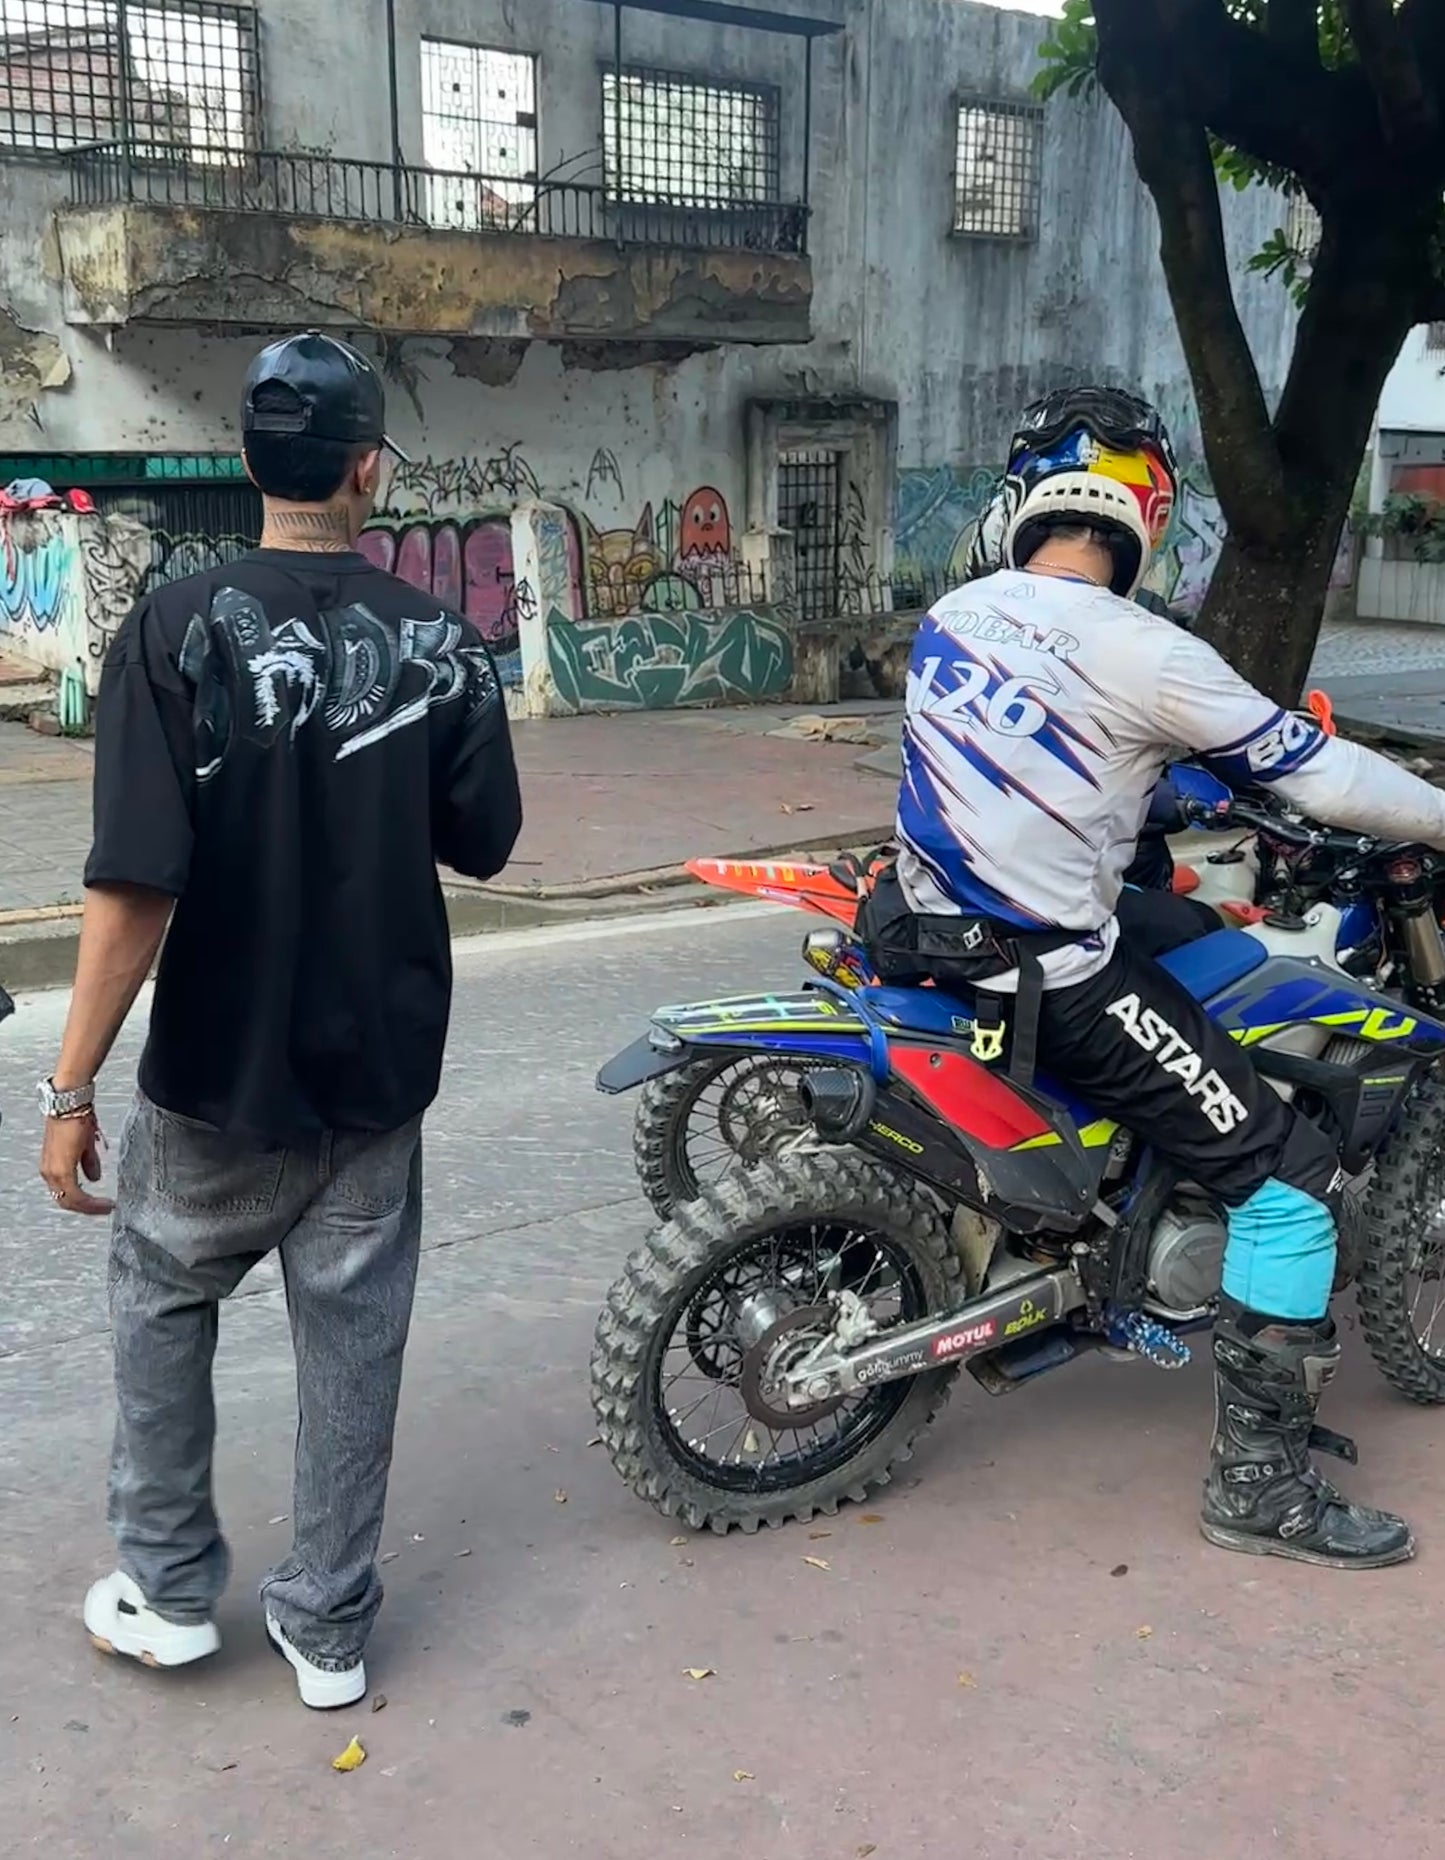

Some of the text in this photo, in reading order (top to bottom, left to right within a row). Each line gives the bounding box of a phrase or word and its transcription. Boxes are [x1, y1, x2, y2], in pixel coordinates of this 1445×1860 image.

[908, 656, 1061, 738] 126
[1105, 992, 1249, 1134] ASTARS
[936, 1321, 993, 1355] MOTUL
